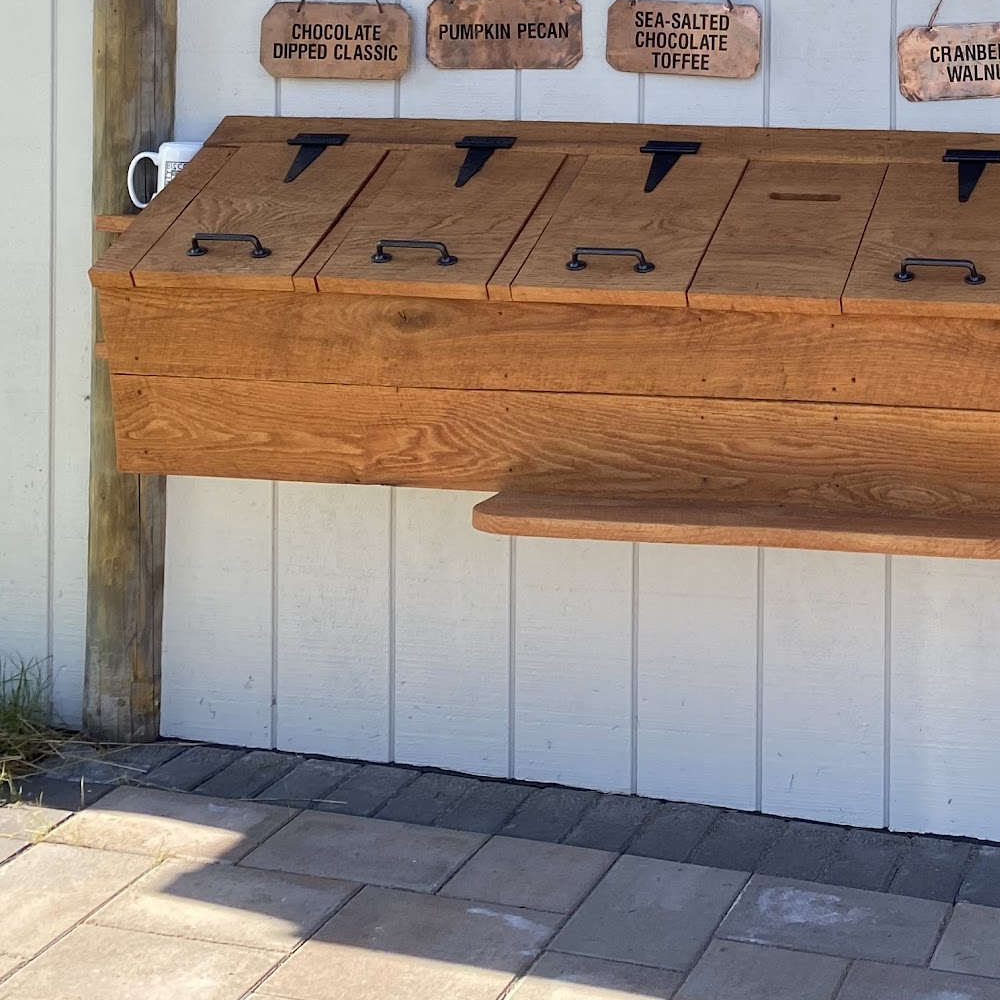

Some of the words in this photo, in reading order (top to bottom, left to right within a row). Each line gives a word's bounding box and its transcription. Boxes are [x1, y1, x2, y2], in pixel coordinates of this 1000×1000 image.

[438, 23, 511, 41] PUMPKIN
[517, 21, 569, 40] PECAN
[634, 11, 730, 32] SEA-SALTED
[291, 23, 381, 42] CHOCOLATE
[634, 31, 728, 52] CHOCOLATE
[272, 42, 328, 60] DIPPED
[333, 44, 398, 62] CLASSIC
[651, 51, 710, 71] TOFFEE
